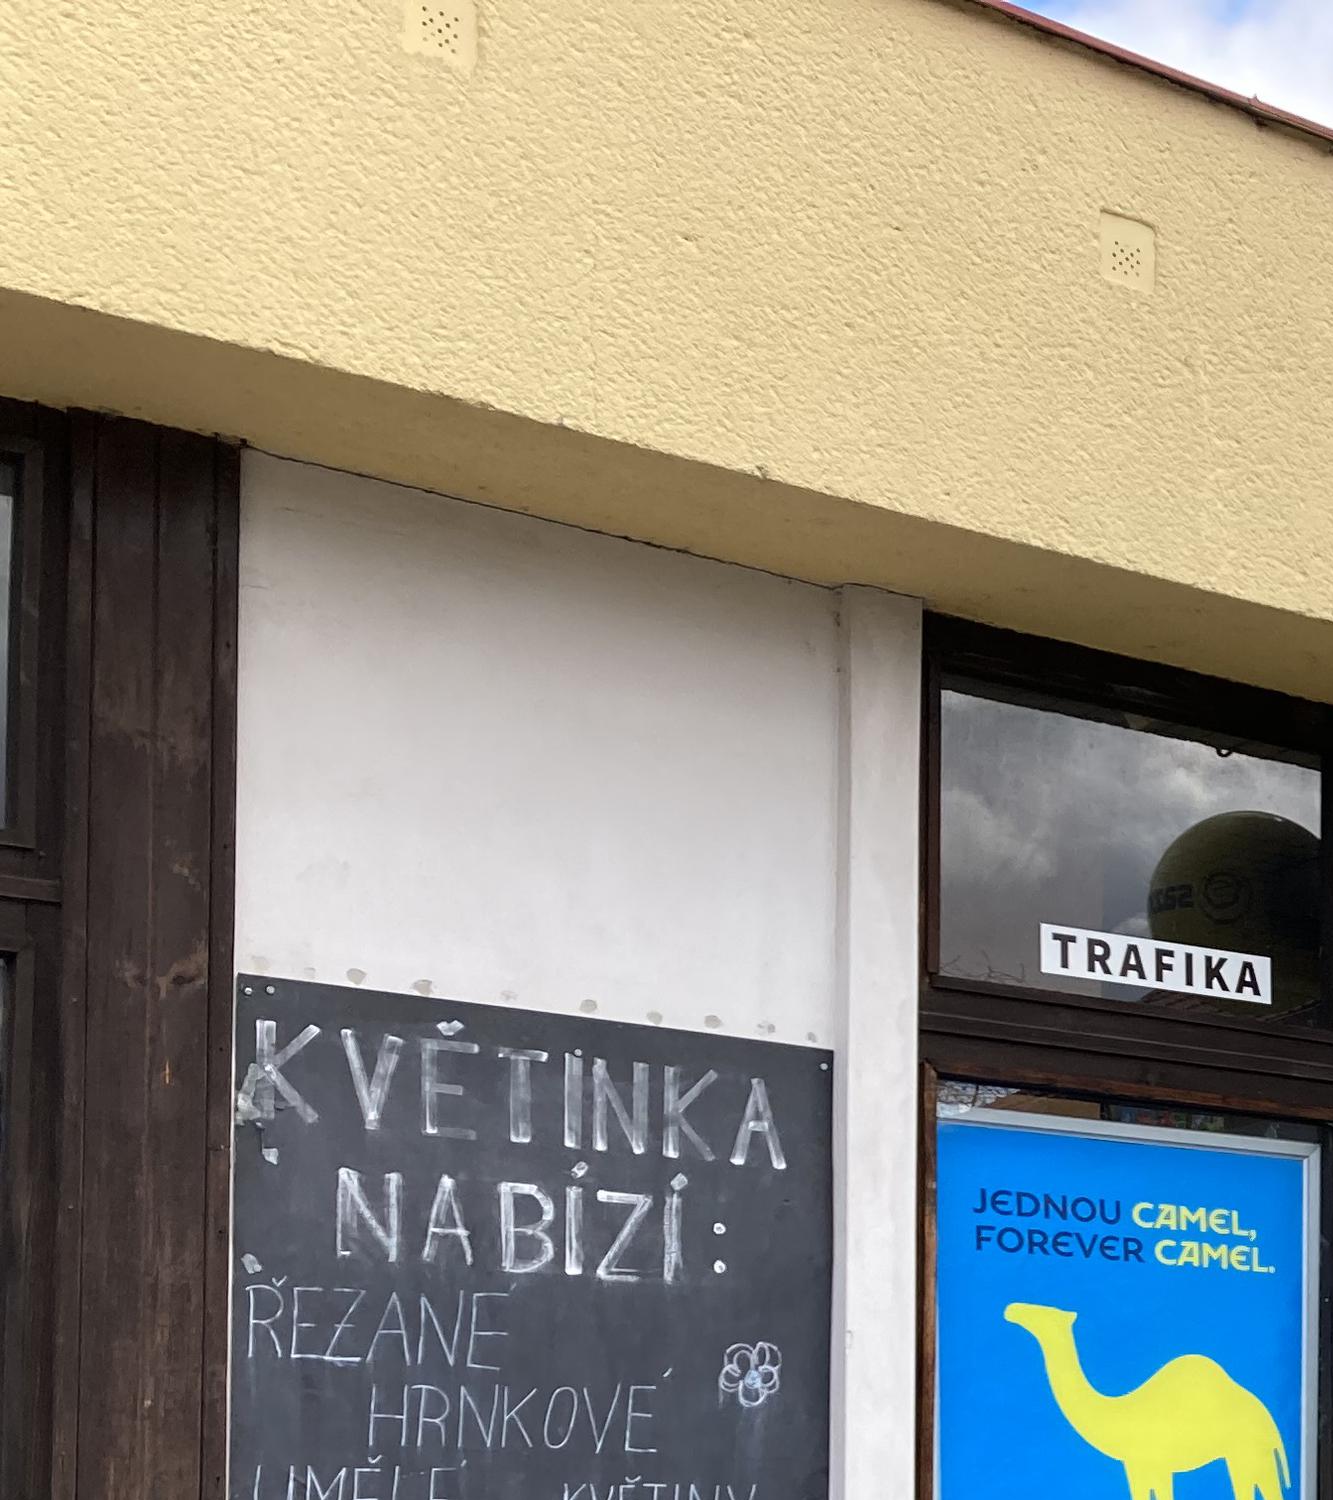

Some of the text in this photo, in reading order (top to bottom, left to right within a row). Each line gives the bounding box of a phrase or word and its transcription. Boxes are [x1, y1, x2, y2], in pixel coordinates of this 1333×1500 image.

[1051, 932, 1262, 997] TRAFIKA
[250, 1018, 787, 1169] KVĚTINKA
[972, 1187, 1257, 1242] JEDNOU CAMEL,
[975, 1226, 1276, 1274] FOREVER CAMEL.
[246, 1276, 519, 1371] ŘEZANÉ
[368, 1367, 673, 1455] HRNKOVÉ
